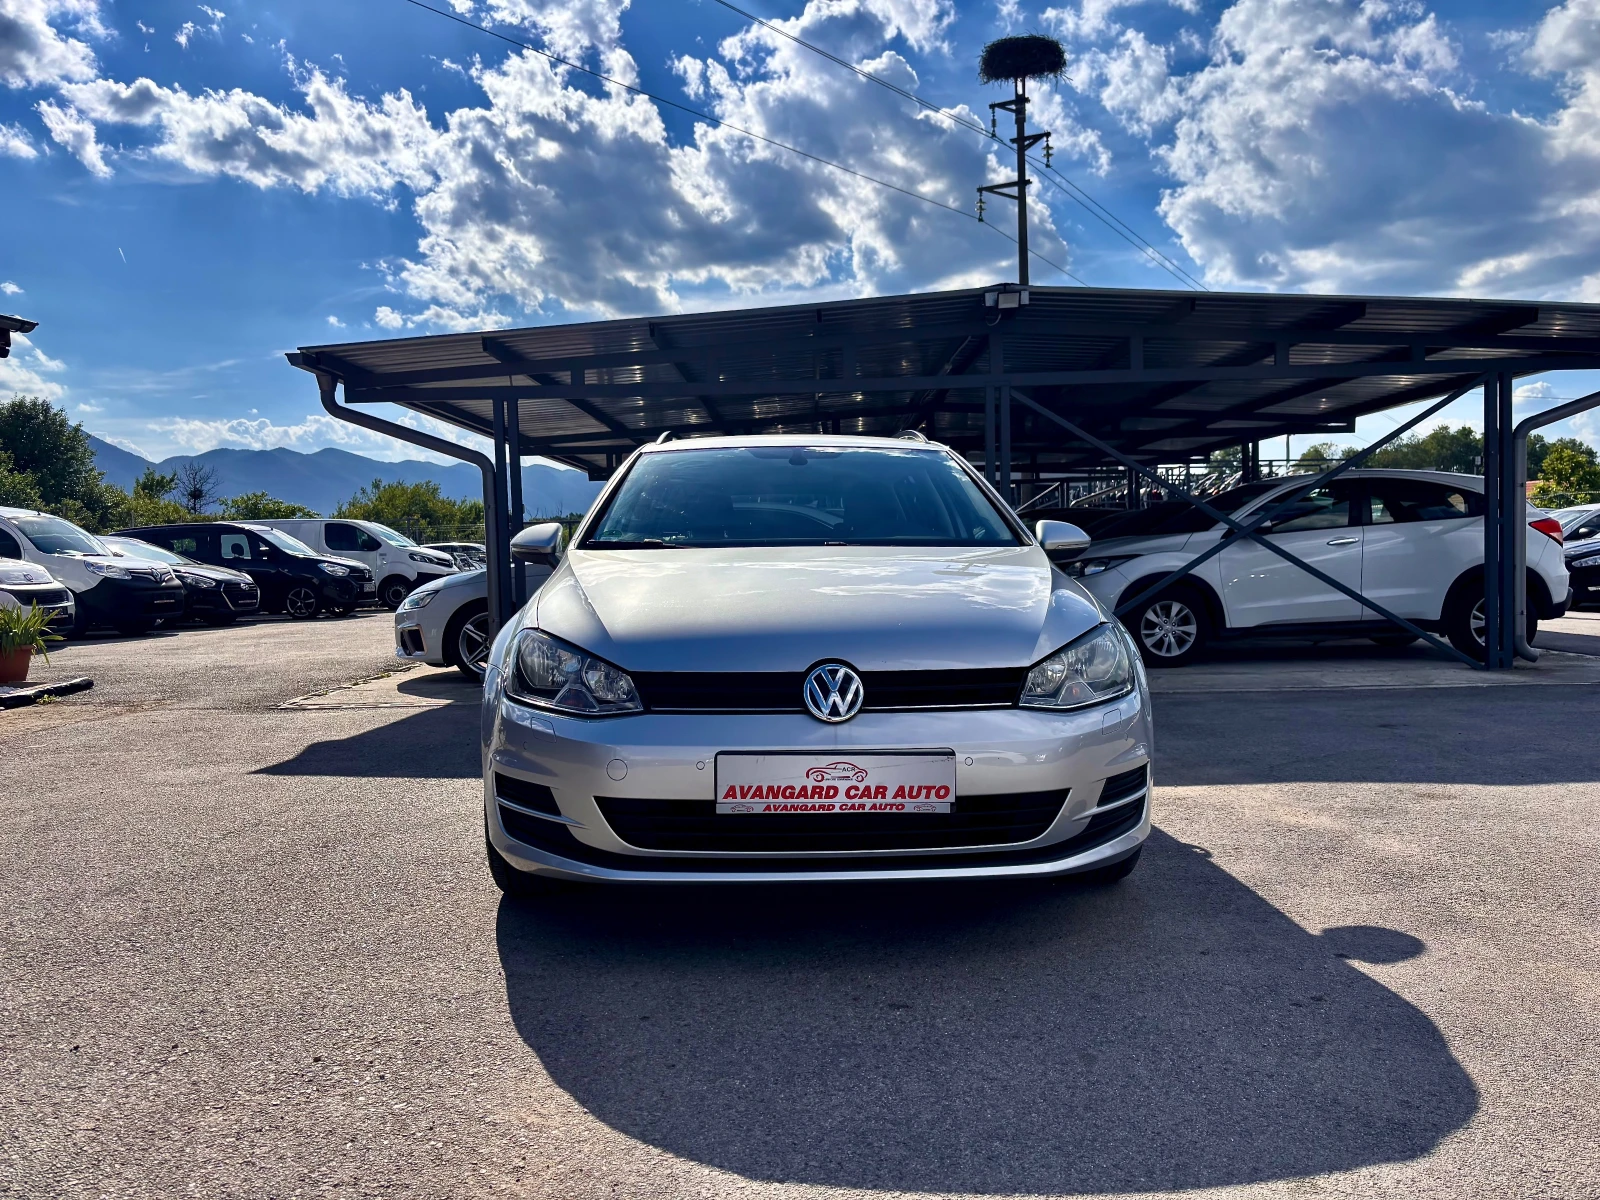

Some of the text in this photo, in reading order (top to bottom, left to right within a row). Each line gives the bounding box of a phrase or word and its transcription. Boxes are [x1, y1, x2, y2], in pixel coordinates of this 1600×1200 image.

[804, 664, 864, 722] VW
[722, 785, 951, 800] AVANGARD CAR AUTO
[762, 803, 906, 812] AVANGARD CAR AUTO
